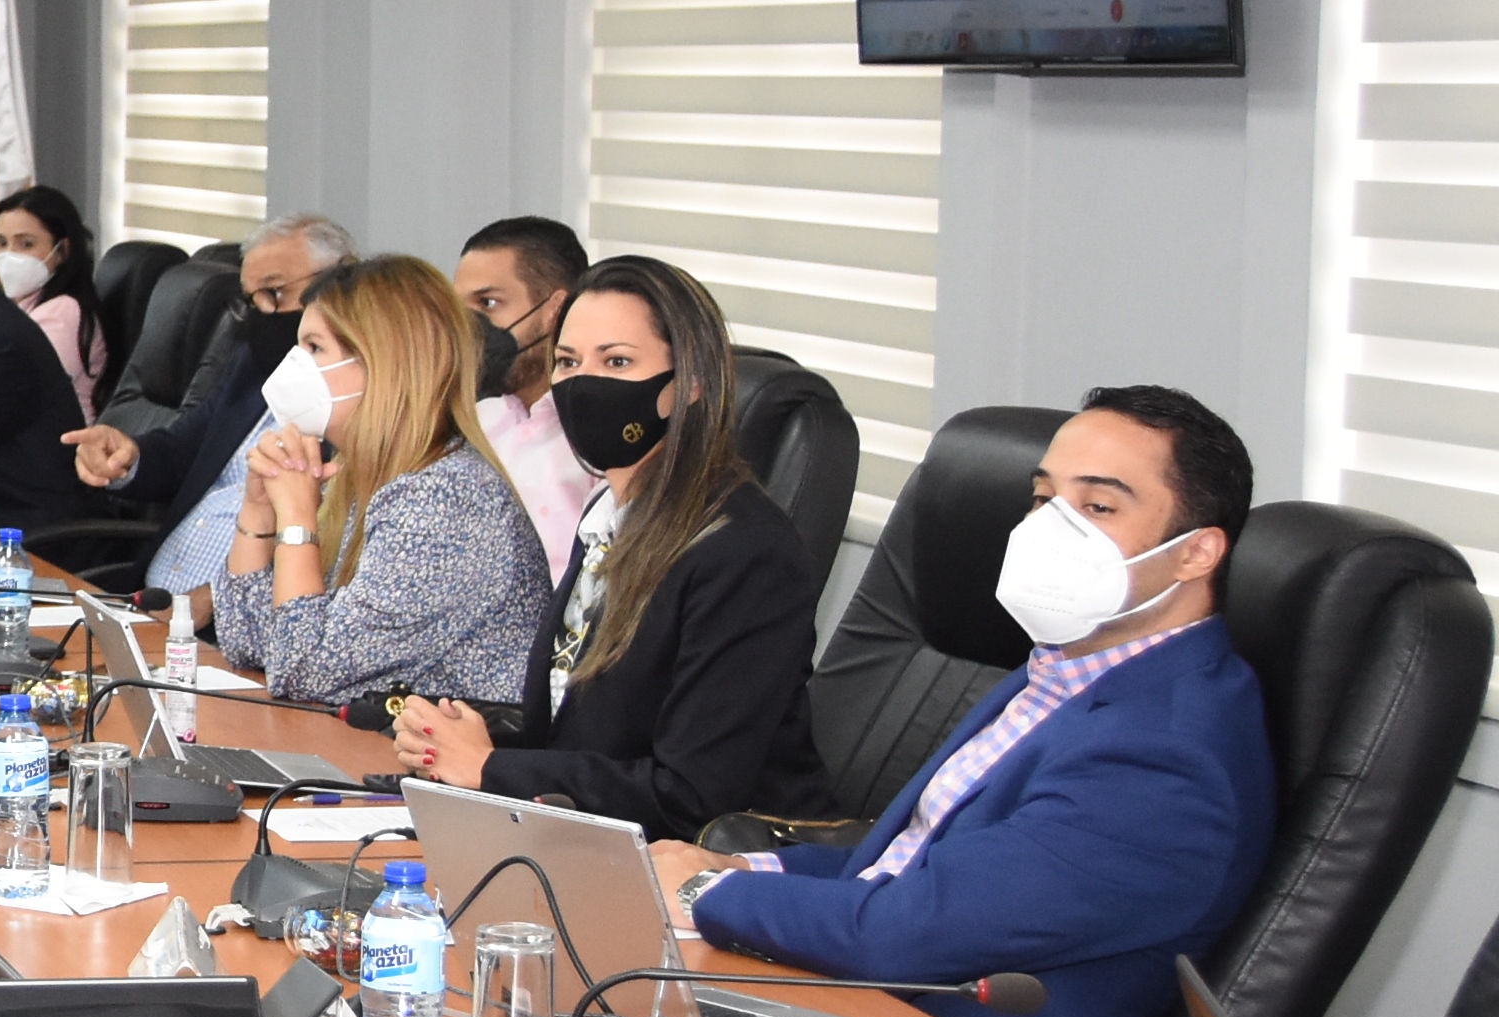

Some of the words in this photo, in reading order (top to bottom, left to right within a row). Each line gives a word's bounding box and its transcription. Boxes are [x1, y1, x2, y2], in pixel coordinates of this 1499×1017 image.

[5, 756, 45, 775] Planeta
[362, 944, 408, 958] Planeta
[376, 948, 413, 968] azul
